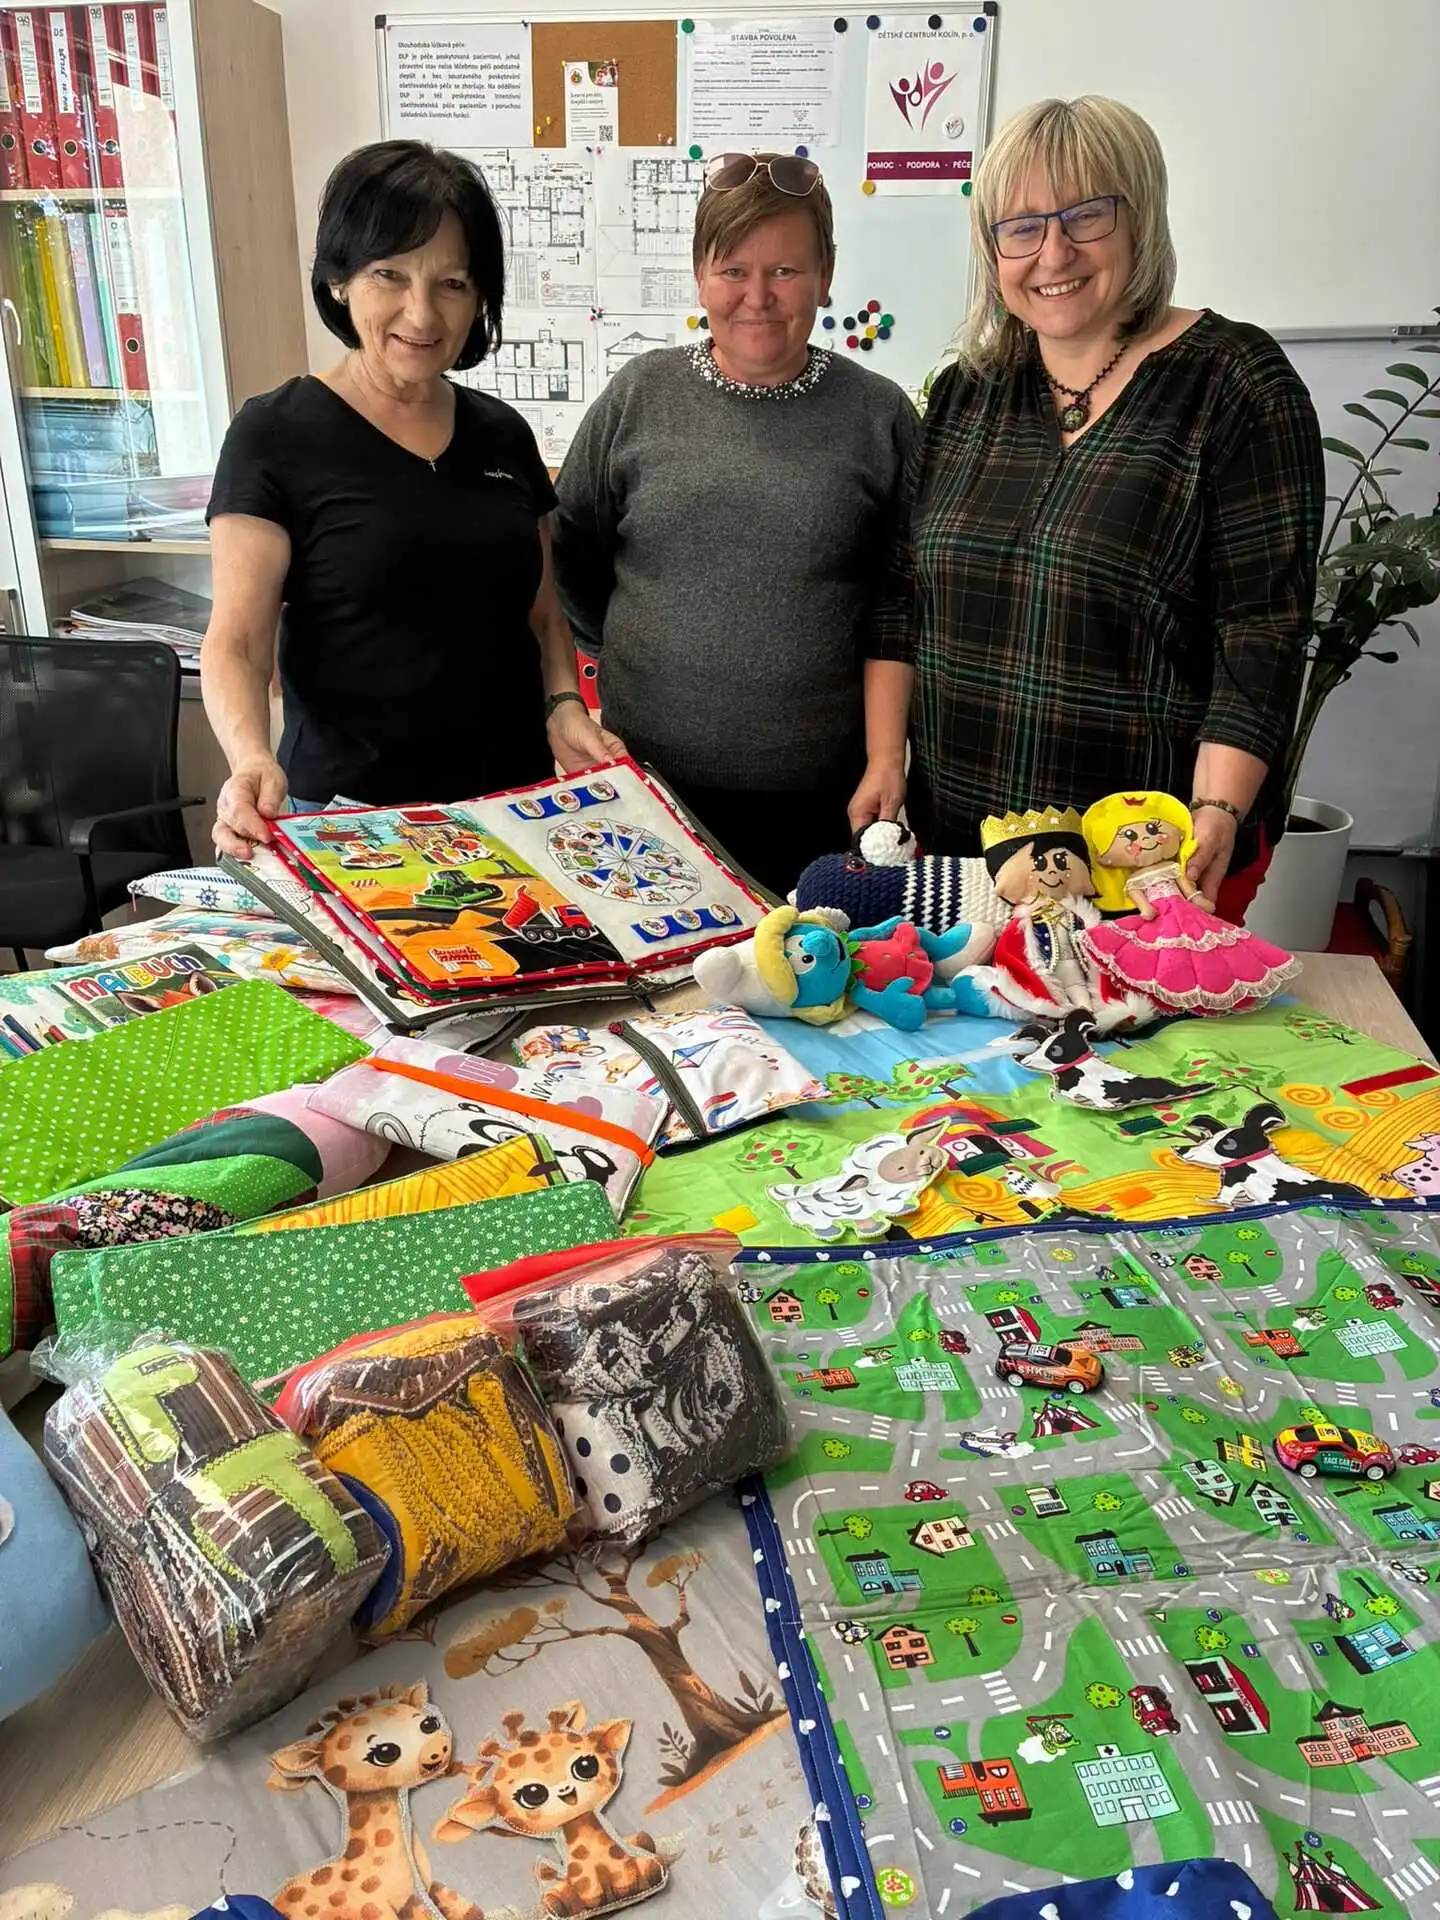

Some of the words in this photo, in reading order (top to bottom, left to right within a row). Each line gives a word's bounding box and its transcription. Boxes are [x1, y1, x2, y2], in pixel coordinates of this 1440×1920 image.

[878, 31, 903, 39] DĚTSKÉ
[938, 30, 960, 39] KOLÍN,
[868, 161, 893, 169] POMOC
[906, 161, 940, 169] PODPORA
